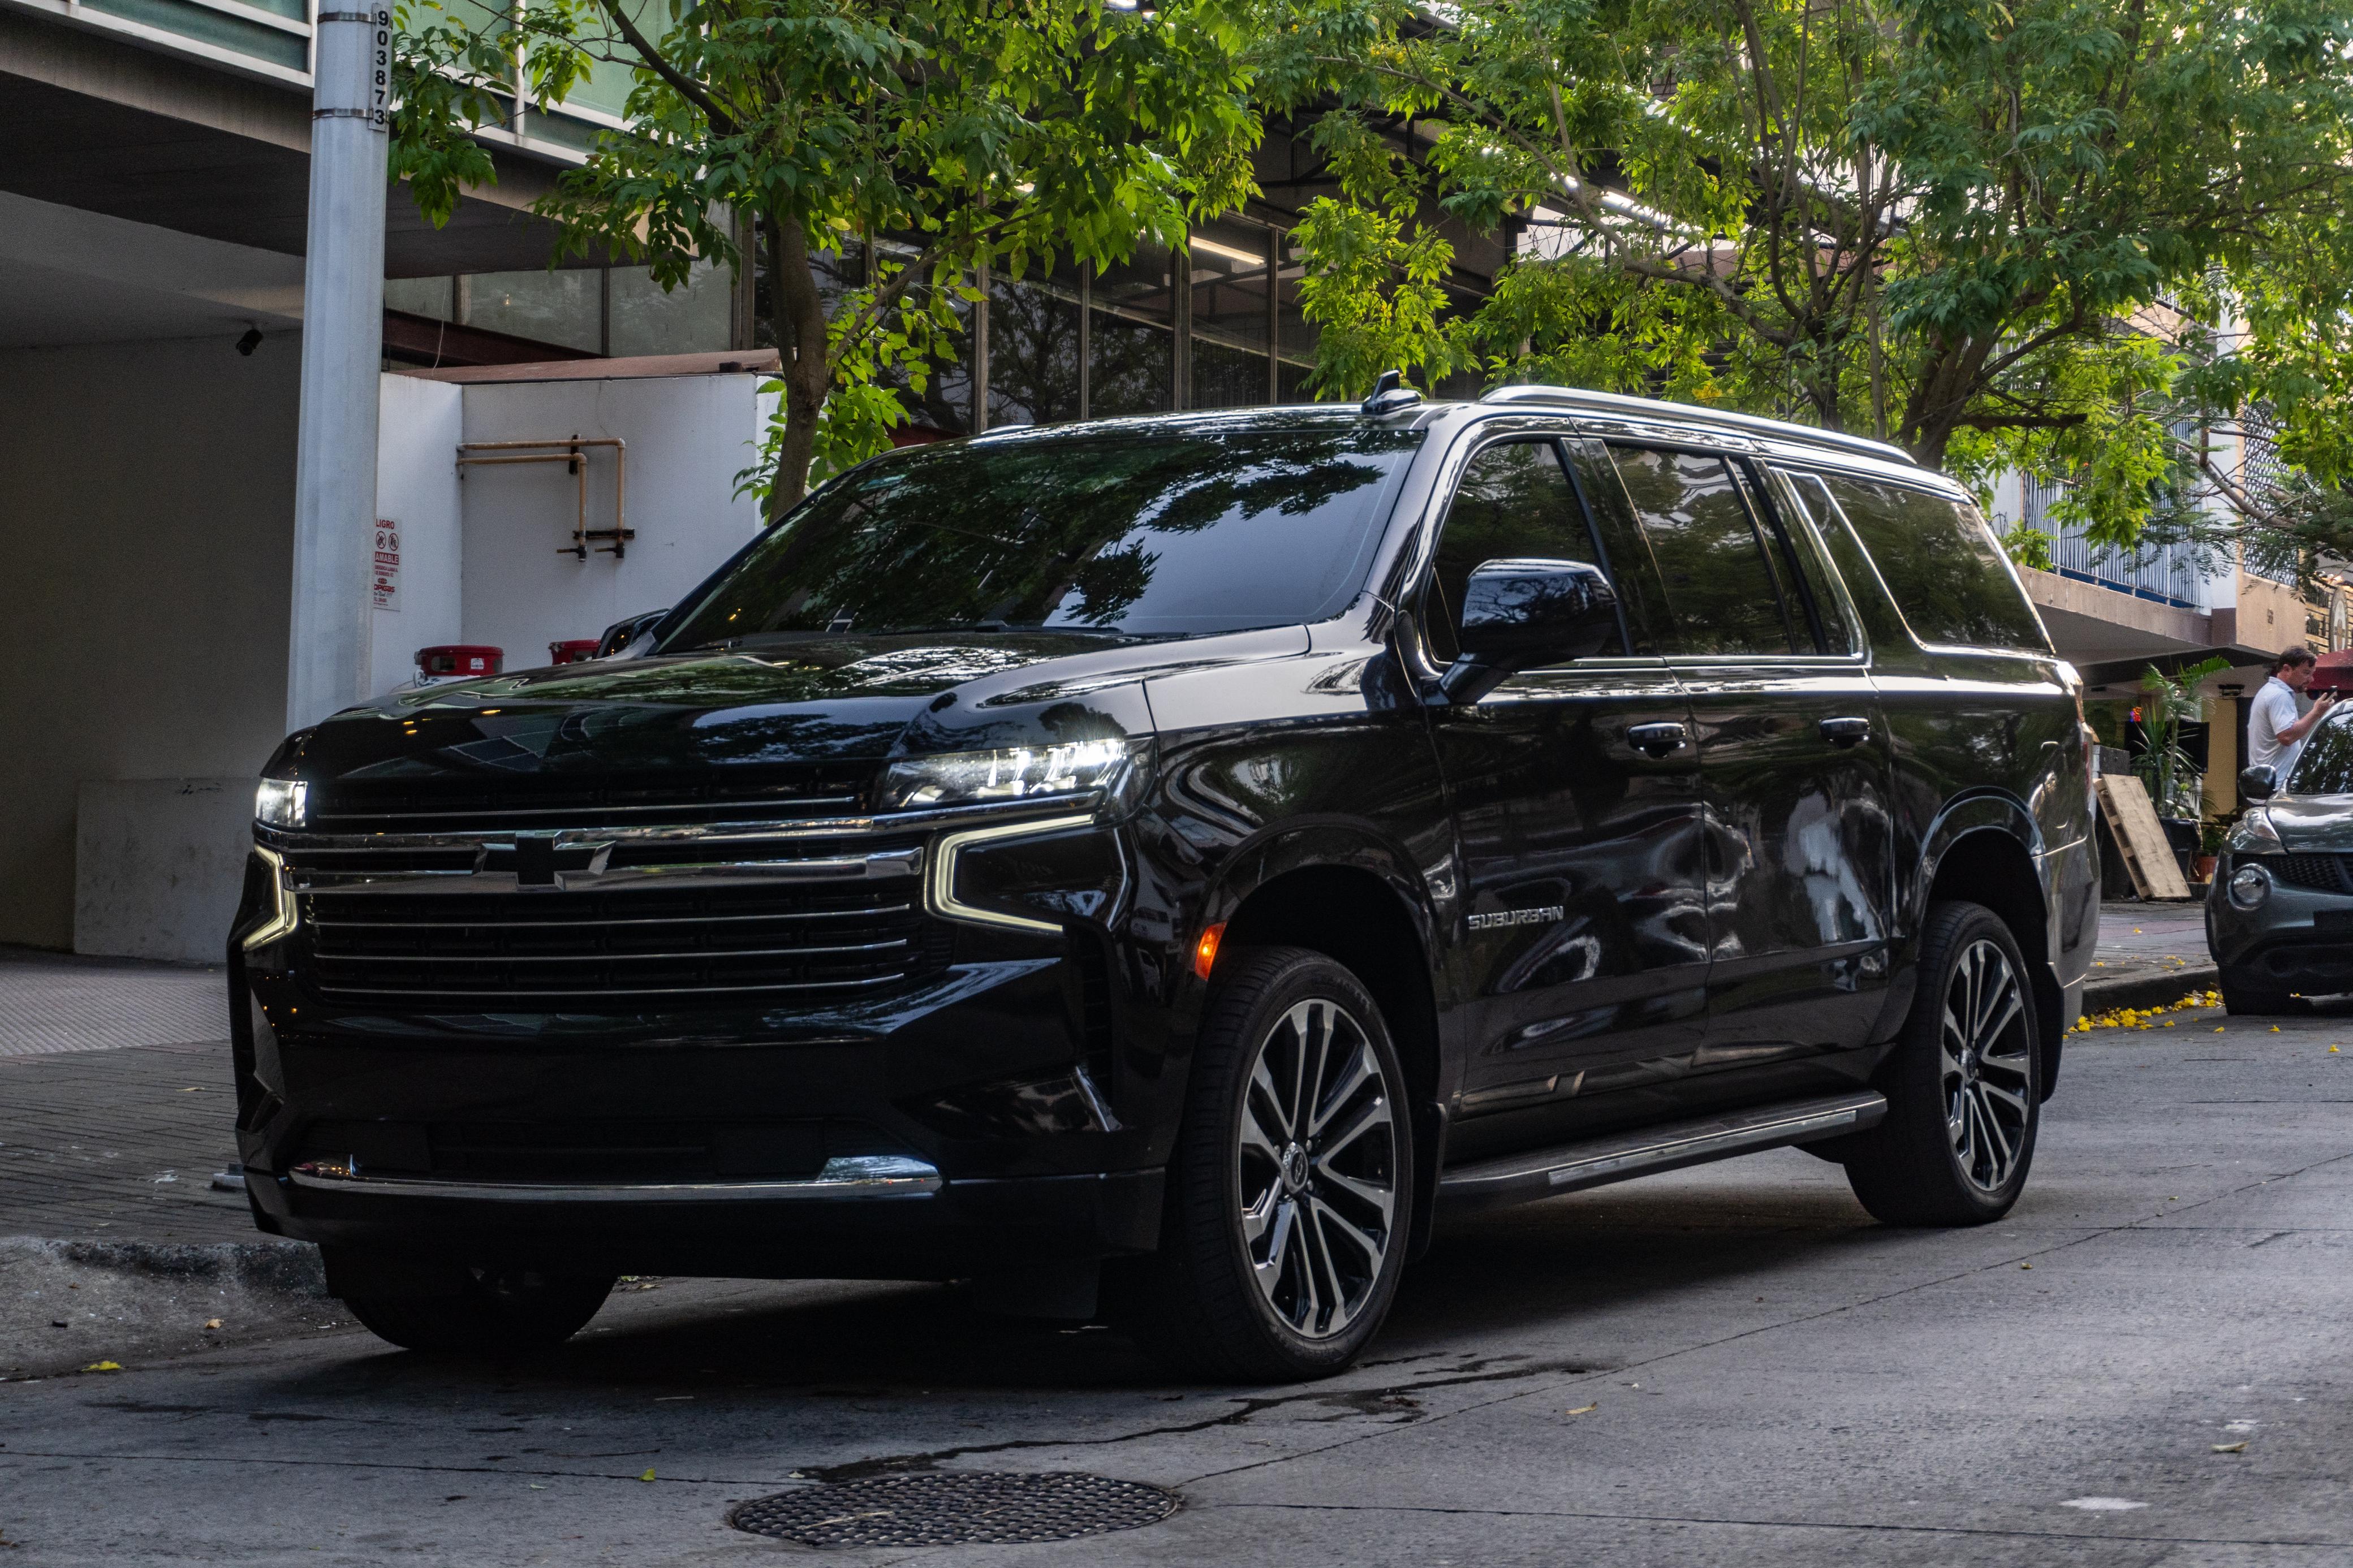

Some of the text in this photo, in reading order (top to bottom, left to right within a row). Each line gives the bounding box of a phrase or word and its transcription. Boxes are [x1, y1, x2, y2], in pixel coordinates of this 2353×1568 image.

[374, 11, 389, 125] 903873
[376, 519, 395, 529] LIGRO
[376, 552, 399, 564] AMABLE
[1468, 905, 1564, 930] SUBURBAN
